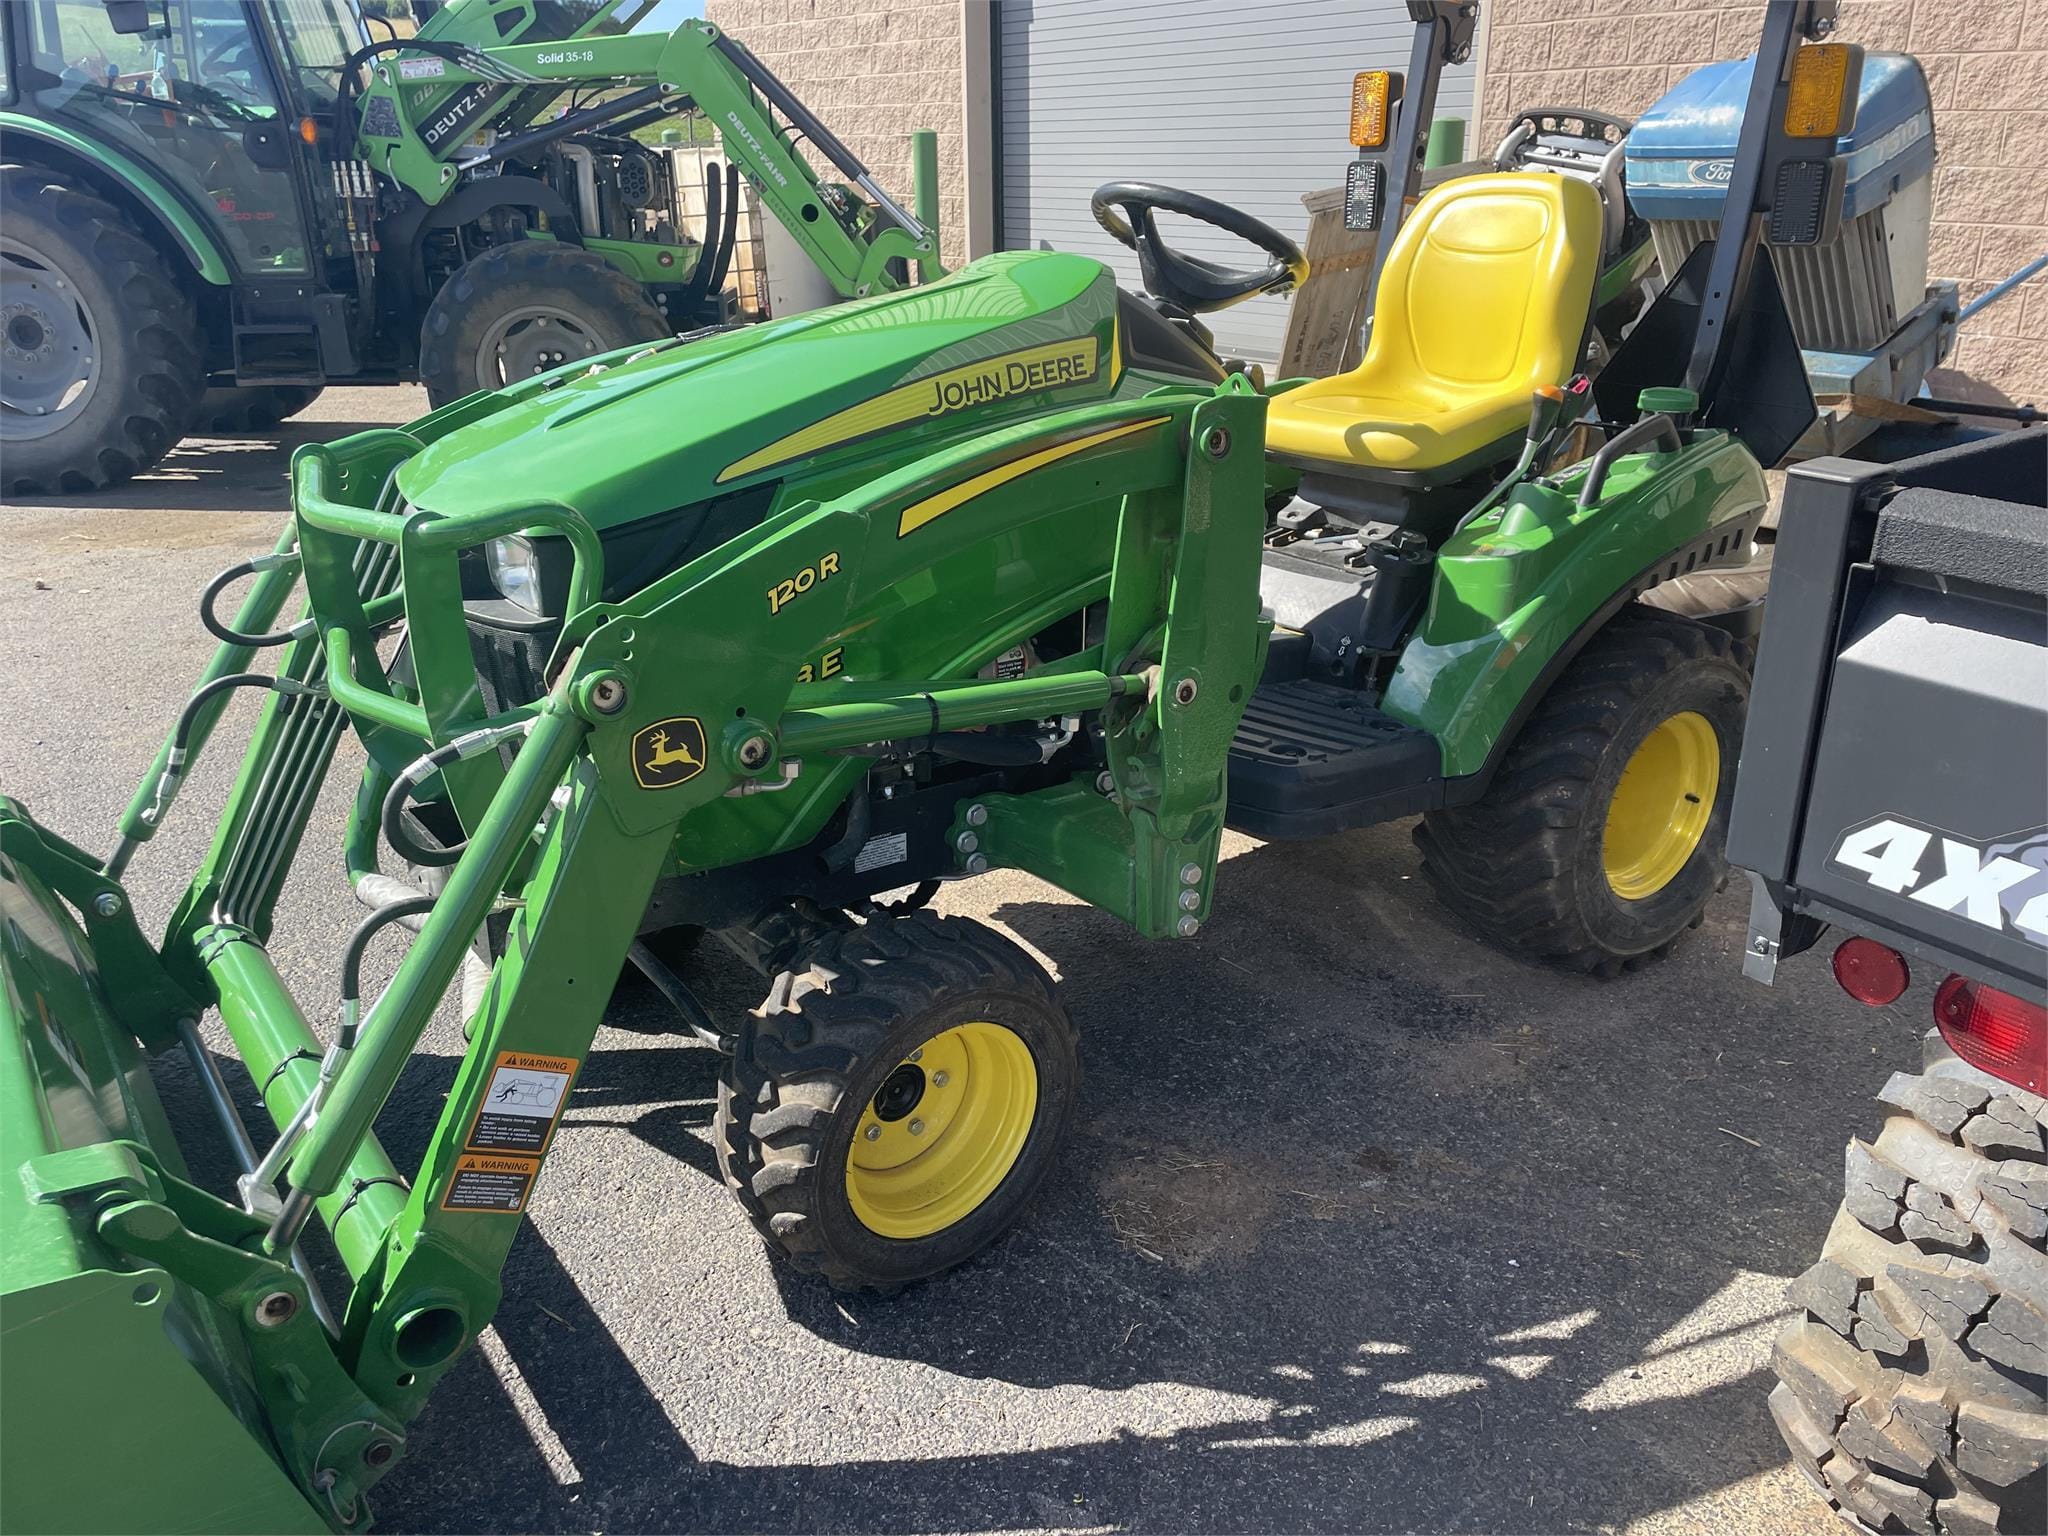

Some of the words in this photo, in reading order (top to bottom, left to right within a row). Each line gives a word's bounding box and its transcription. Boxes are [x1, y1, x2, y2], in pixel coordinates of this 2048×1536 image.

[537, 53, 564, 64] Solid
[565, 50, 594, 63] 35-18
[424, 81, 498, 145] DEUTZ-FA
[727, 111, 788, 187] DEUTZ-FAHR
[928, 372, 1001, 413] JOHN
[1006, 354, 1088, 391] DEERE
[519, 1058, 568, 1071] WARNING
[480, 1160, 530, 1171] WARNING
